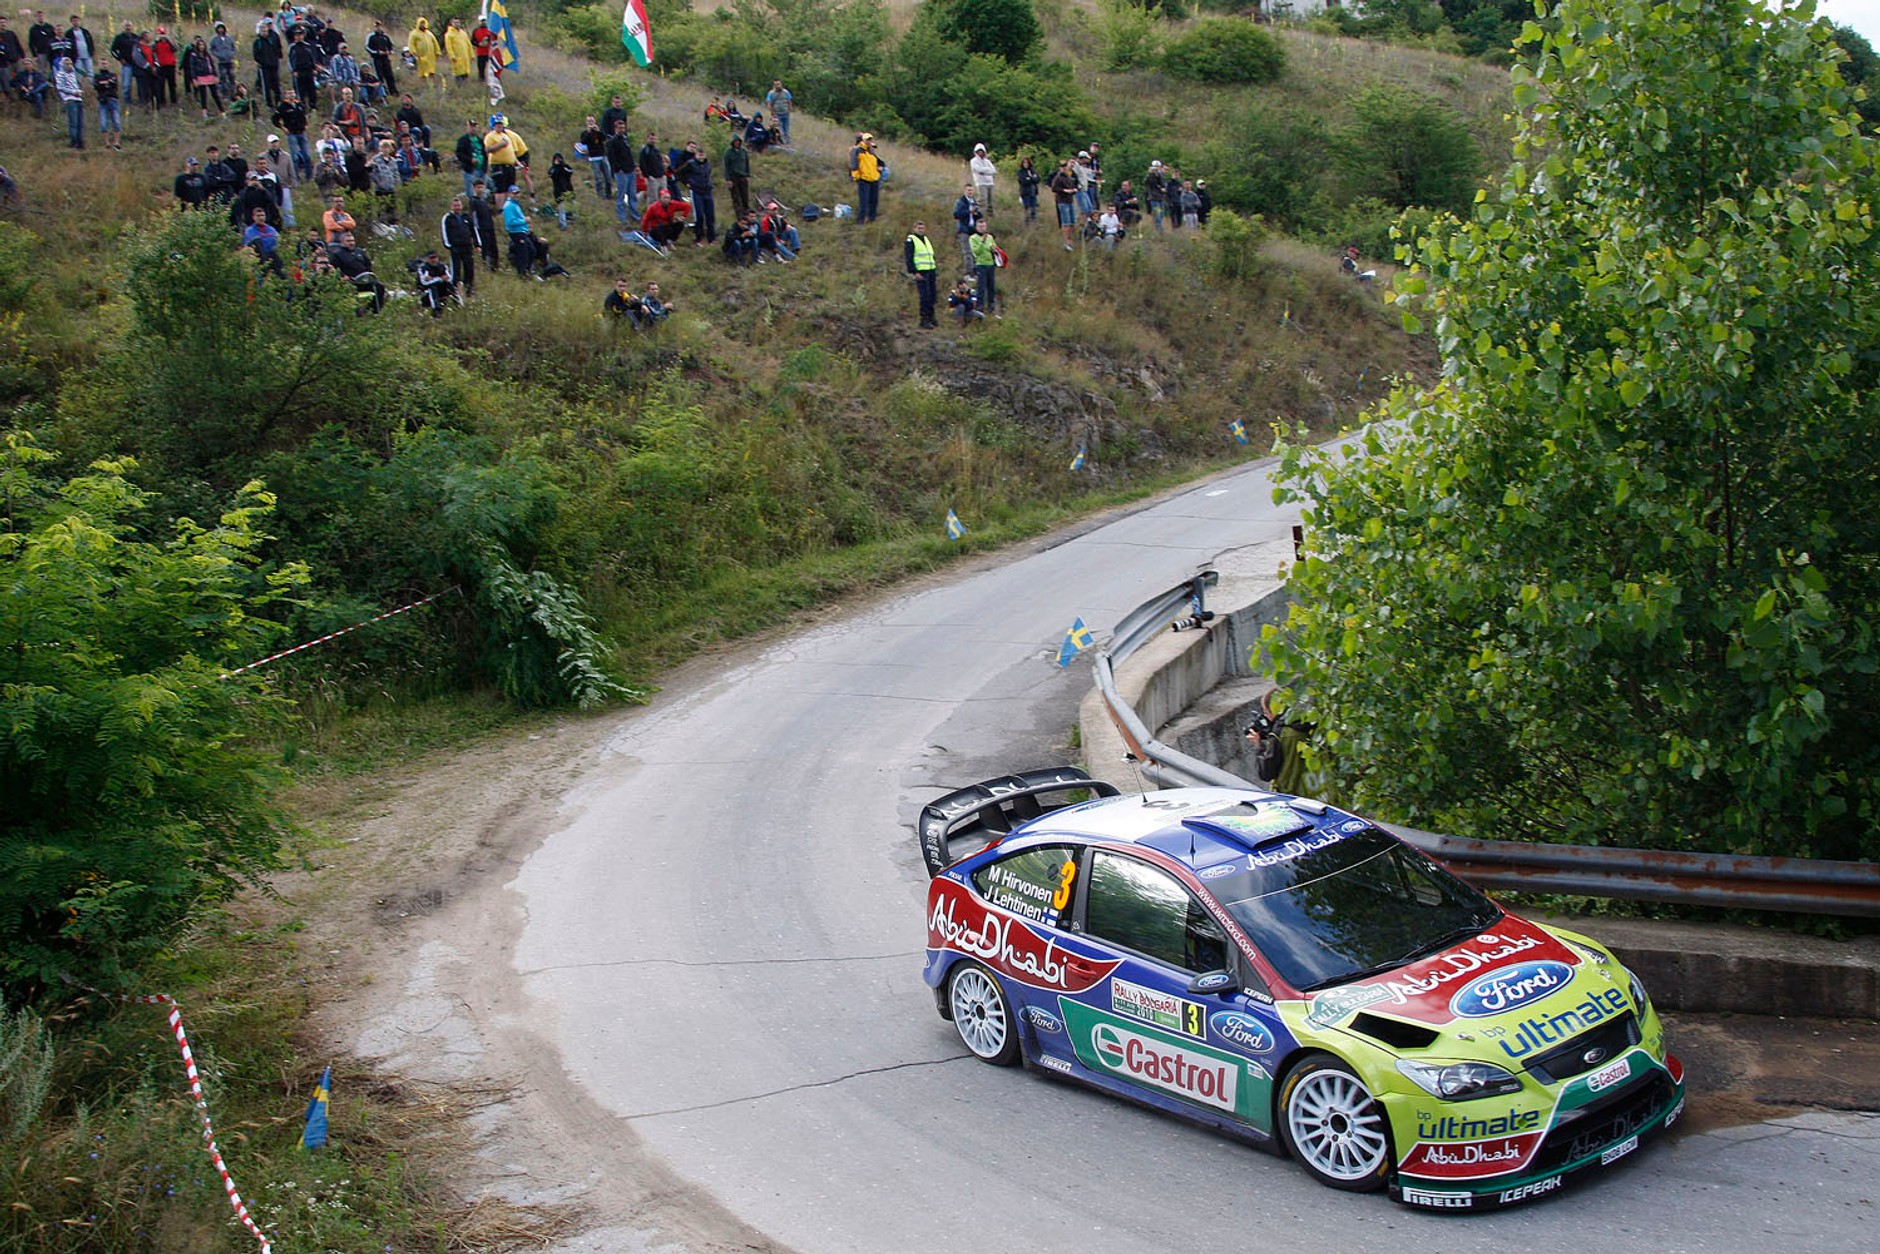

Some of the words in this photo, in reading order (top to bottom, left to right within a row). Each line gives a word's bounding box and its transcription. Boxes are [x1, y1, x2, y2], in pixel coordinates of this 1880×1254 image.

[988, 865, 1000, 883] M
[1001, 870, 1053, 904] Hirvonen
[1053, 860, 1077, 911] 3
[984, 885, 993, 900] J
[994, 890, 1042, 921] Lehtinen
[1198, 888, 1257, 961] www.wrcford.com
[1114, 982, 1138, 1003] RALLY
[1139, 990, 1179, 1015] BULGARIA
[1474, 968, 1559, 1009] Ford
[1030, 1008, 1056, 1031] Ford
[1188, 1004, 1199, 1035] 3
[1222, 1016, 1264, 1049] Ford
[1479, 1024, 1507, 1039] bp
[1499, 986, 1629, 1058] ultimate
[1126, 1039, 1228, 1102] Castrol
[1599, 1062, 1629, 1086] Castrol
[1416, 1109, 1432, 1121] bp
[1418, 1108, 1540, 1139] ultimate
[1402, 1186, 1472, 1207] PIRELLI
[1499, 1175, 1562, 1203] ICEPEAK
